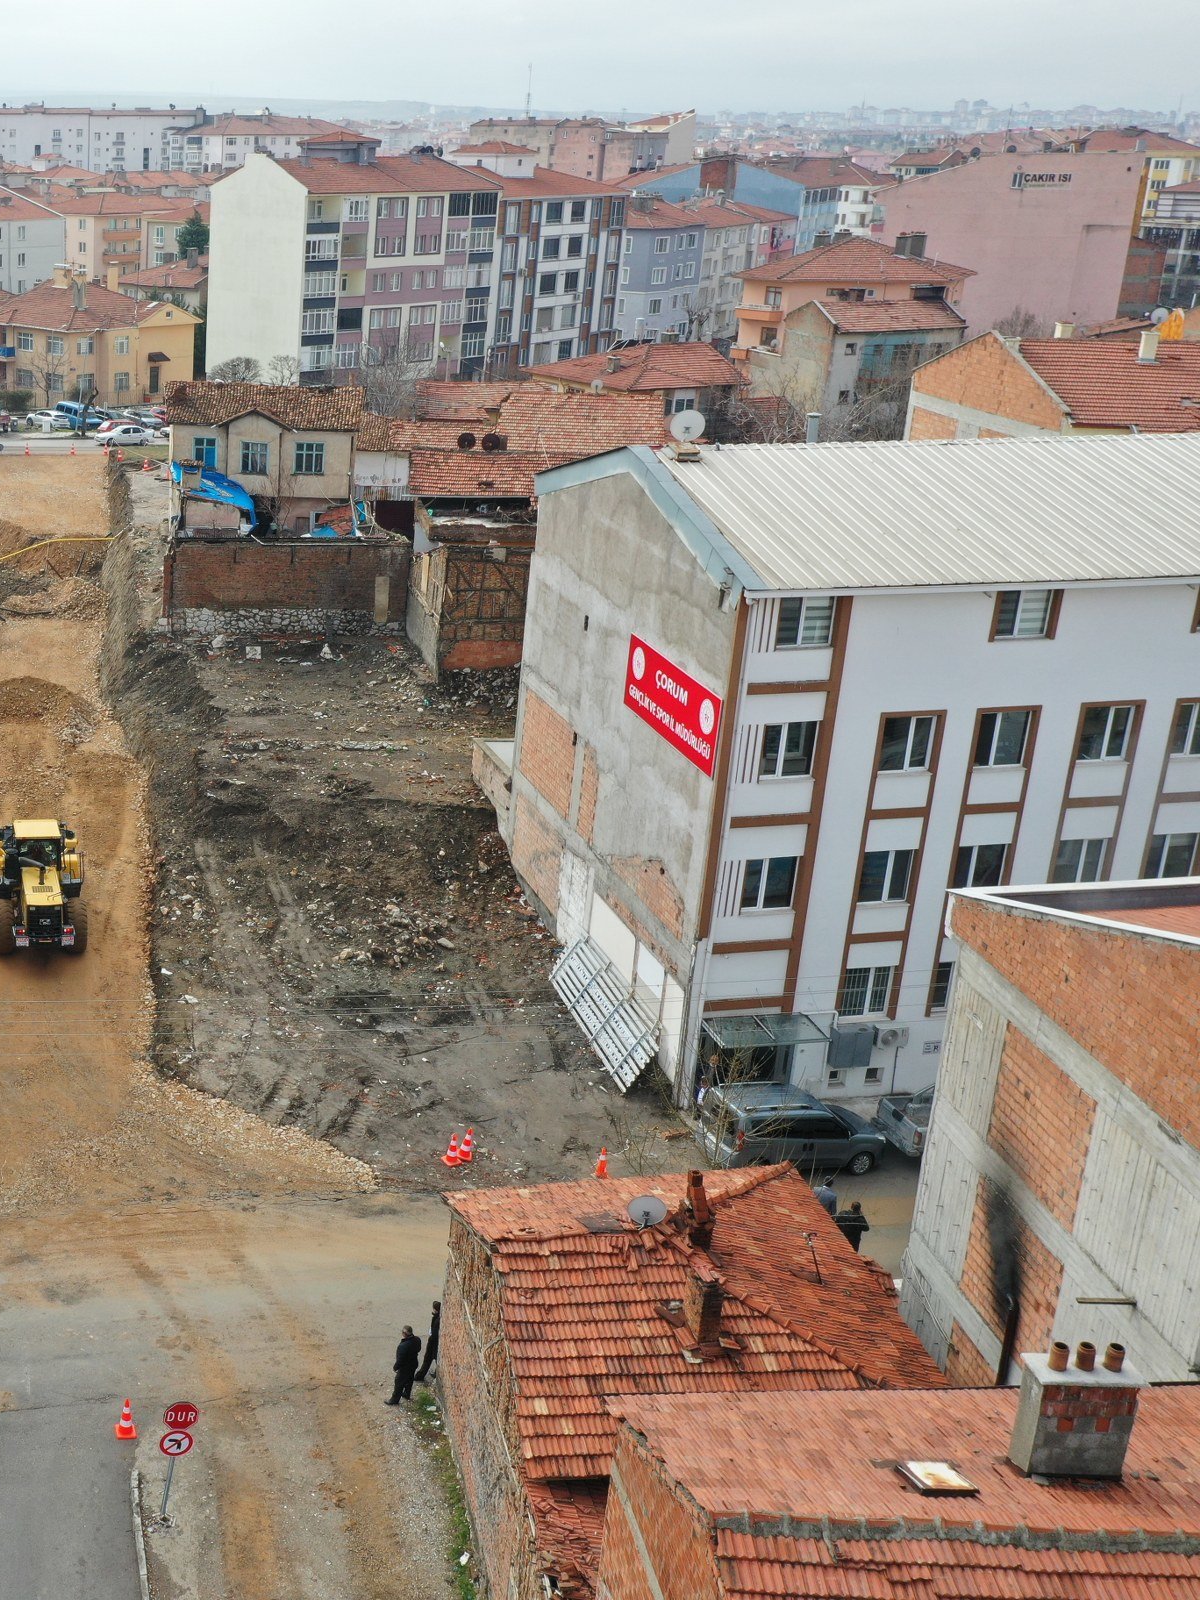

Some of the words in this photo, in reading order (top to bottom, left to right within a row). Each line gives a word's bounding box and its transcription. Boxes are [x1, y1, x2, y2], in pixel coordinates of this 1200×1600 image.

[655, 669, 688, 706] ÇORUM
[629, 684, 649, 711] GENÇLİK
[649, 699, 657, 716] VE
[656, 706, 670, 728] SPOR
[675, 721, 711, 759] MÜDÜRLÜĞÜ
[166, 1411, 196, 1422] DUR
